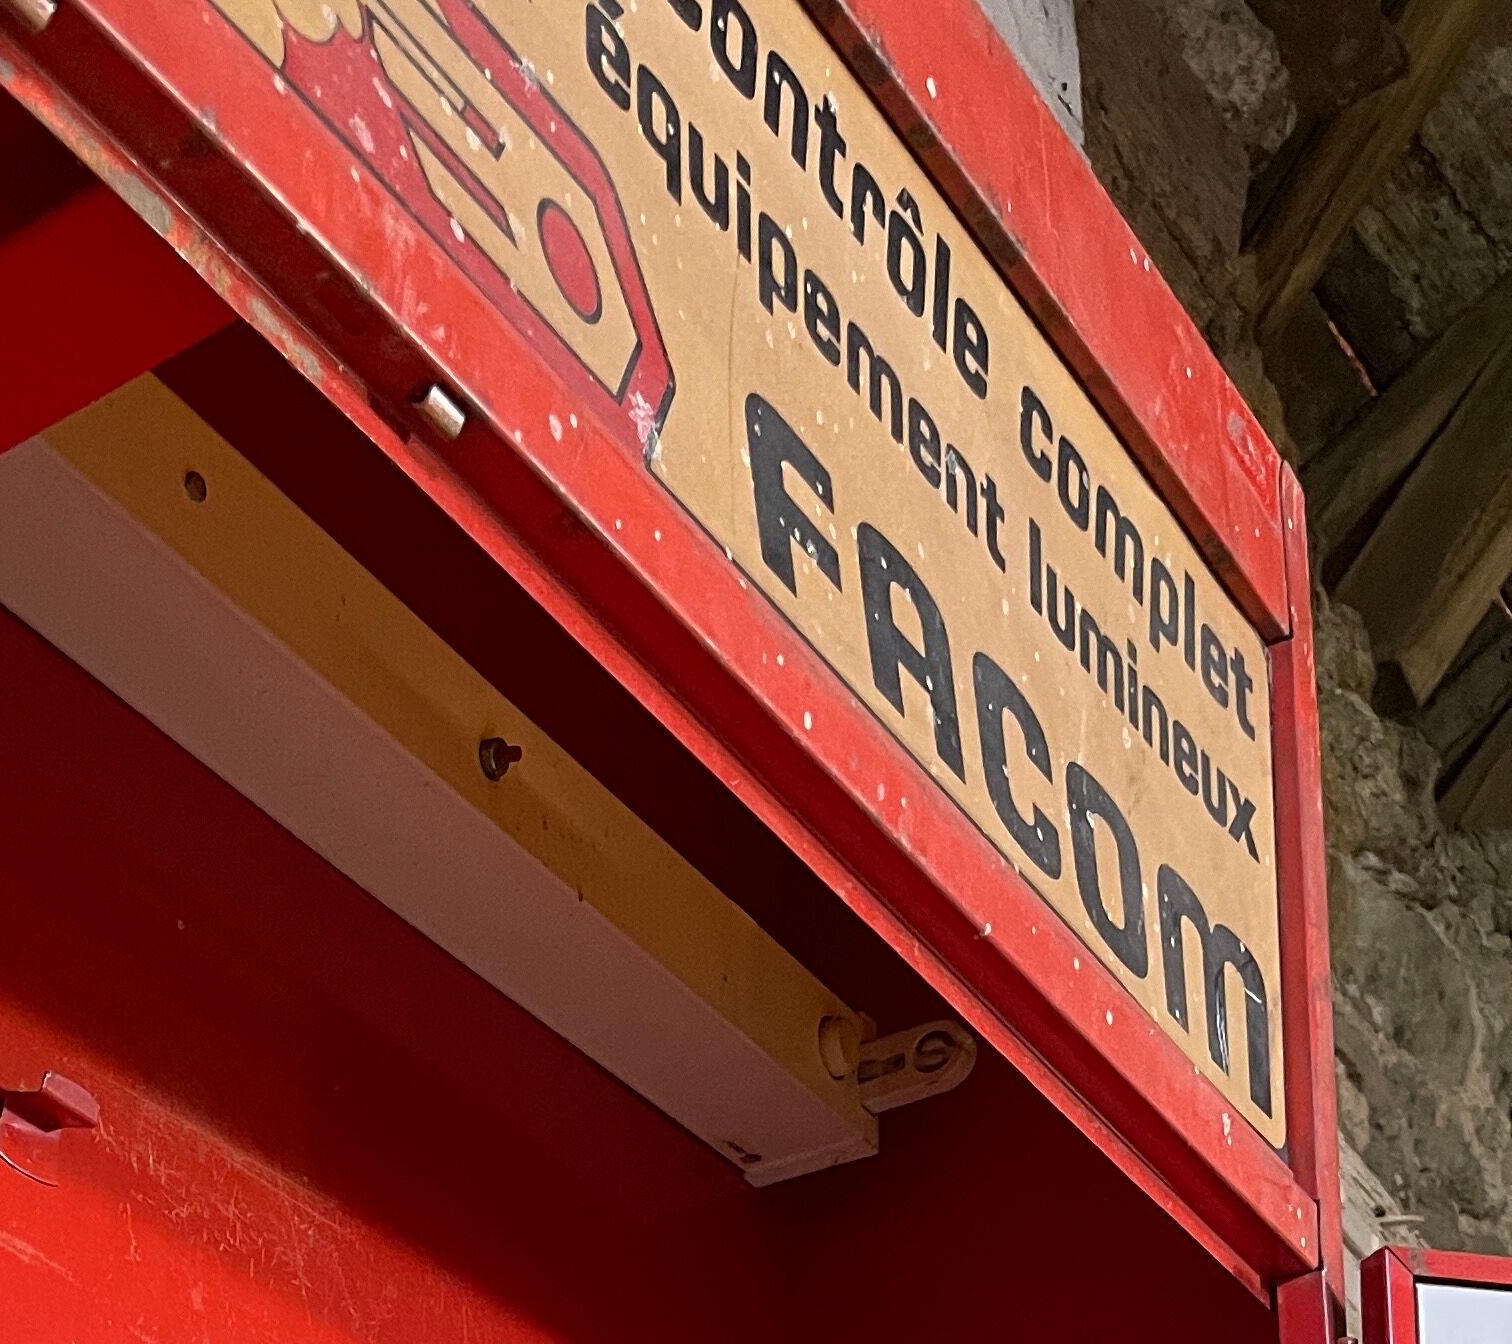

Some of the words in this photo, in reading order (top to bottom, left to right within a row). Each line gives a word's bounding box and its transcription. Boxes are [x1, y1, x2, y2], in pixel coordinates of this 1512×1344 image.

[586, 0, 1005, 574] équipement
[1029, 517, 1260, 864] lumineux
[666, 0, 989, 400] ontrôle
[1020, 386, 1256, 742] complet
[745, 392, 1273, 1120] FACOM
